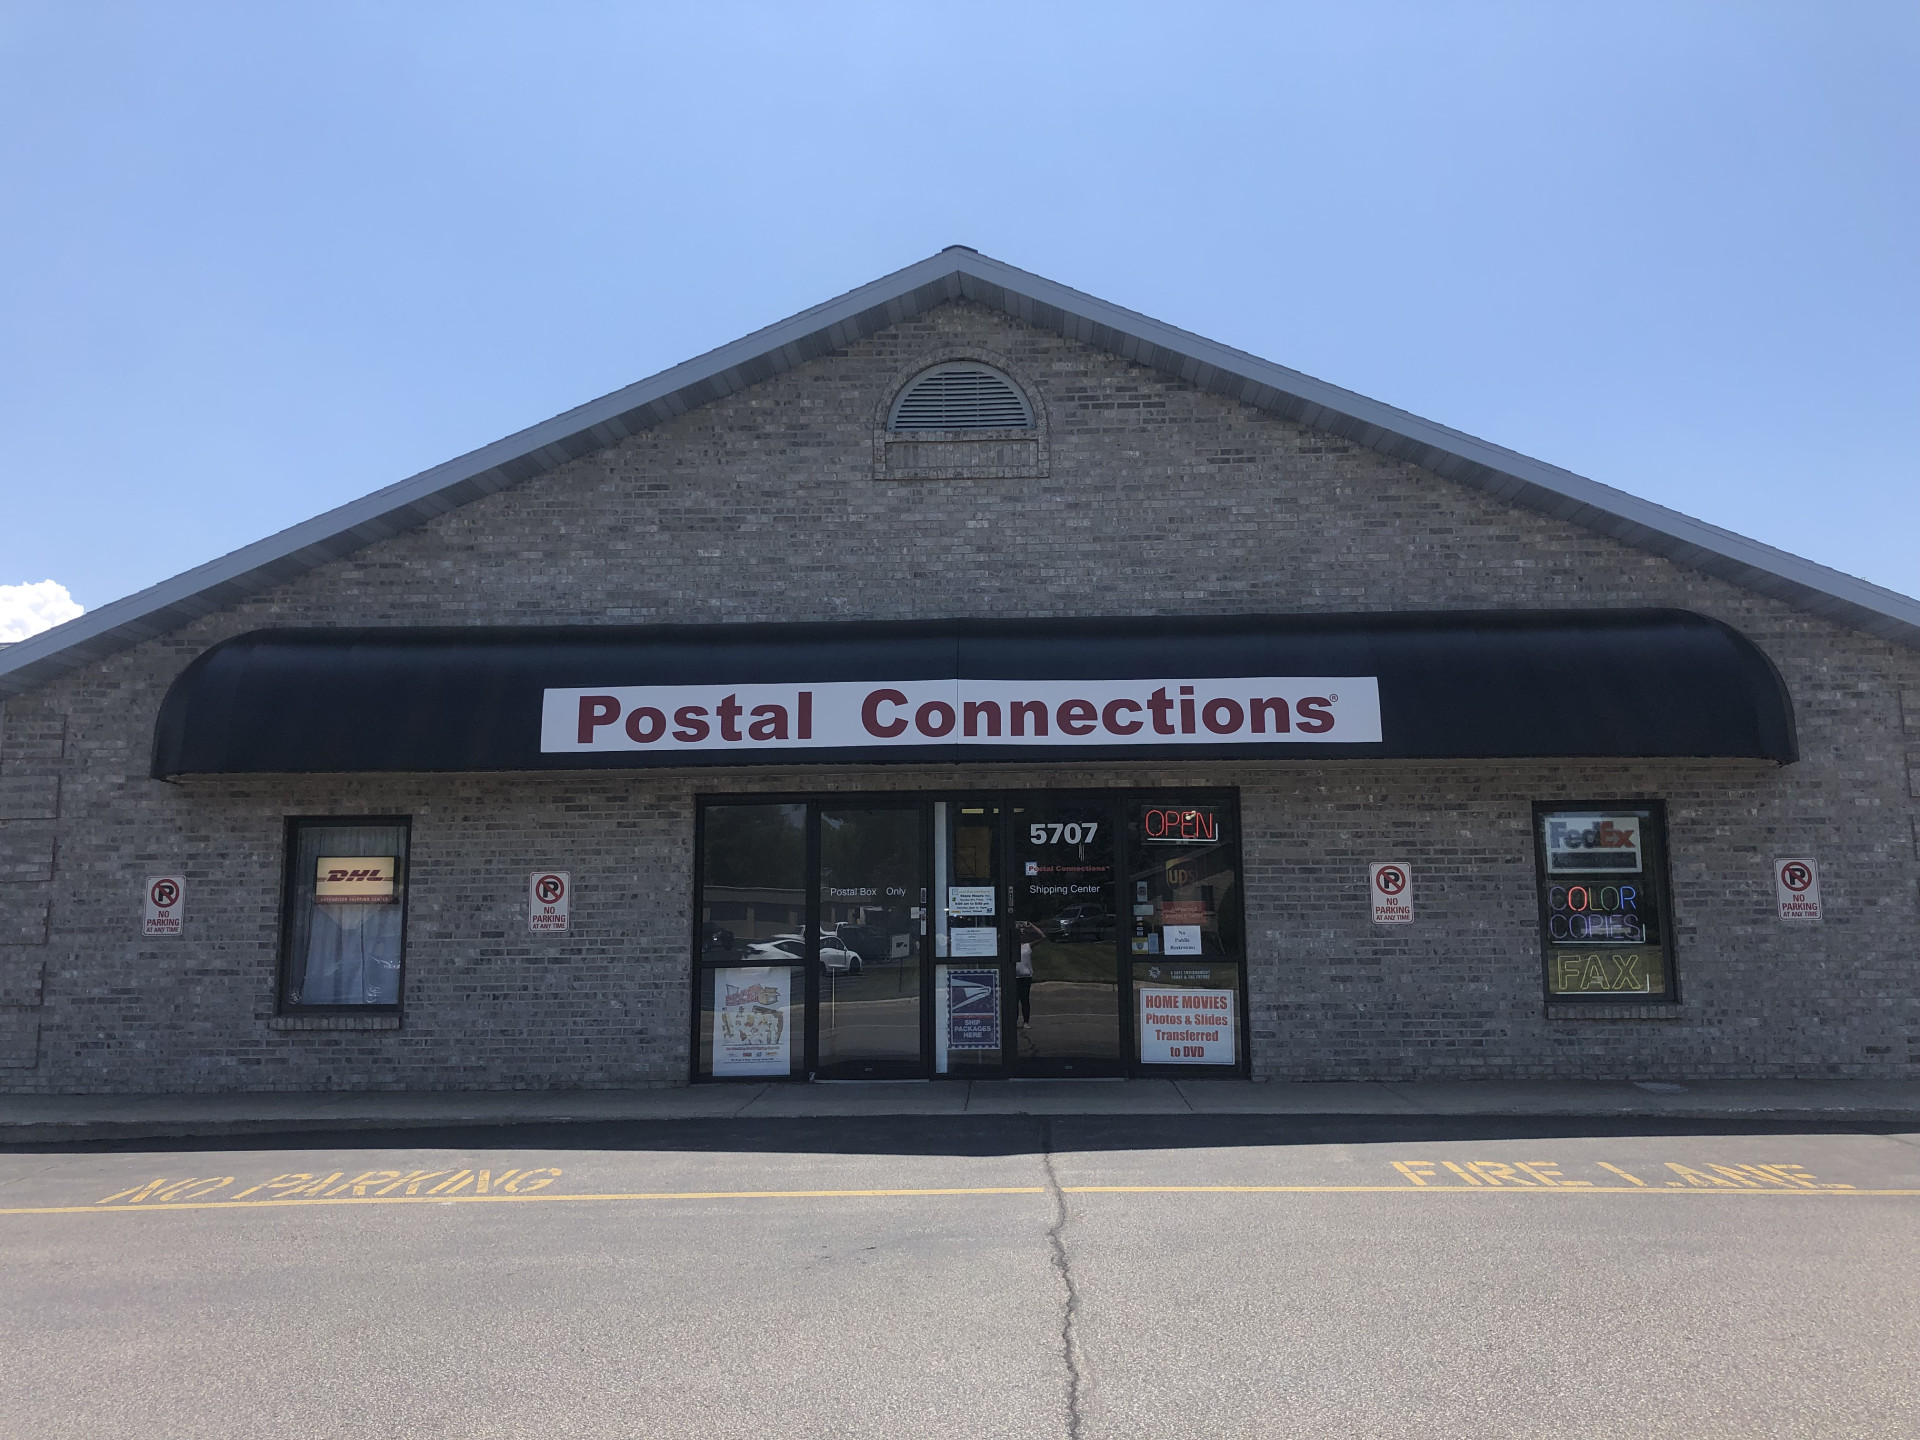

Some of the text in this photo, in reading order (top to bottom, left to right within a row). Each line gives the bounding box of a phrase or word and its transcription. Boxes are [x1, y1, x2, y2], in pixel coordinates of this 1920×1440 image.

[577, 691, 813, 744] Postal
[1145, 809, 1213, 839] OPEN
[1030, 822, 1098, 845] 5707
[1550, 820, 1636, 850] FedEx
[326, 869, 384, 882] DHL
[830, 887, 906, 897] Postal Box Only
[1029, 884, 1100, 895] Shipping Center
[1549, 885, 1637, 911] COLOR
[1793, 894, 1805, 902] NO
[543, 906, 555, 914] NO
[1375, 906, 1410, 914] PARKING
[1781, 902, 1818, 911] PARKING
[158, 910, 169, 918] NO
[532, 914, 566, 923] PARKING
[146, 918, 179, 927] PARKING
[1550, 914, 1641, 939] COPIES
[1557, 954, 1641, 990] FAX
[1145, 995, 1228, 1010] HOME MOVIES
[1145, 1013, 1228, 1026] Photos & Slides
[1155, 1029, 1219, 1042] Transferred
[1170, 1046, 1205, 1058] to DVD
[1389, 1160, 1857, 1190] FIRE LANE
[96, 1167, 563, 1204] NO PARKING
